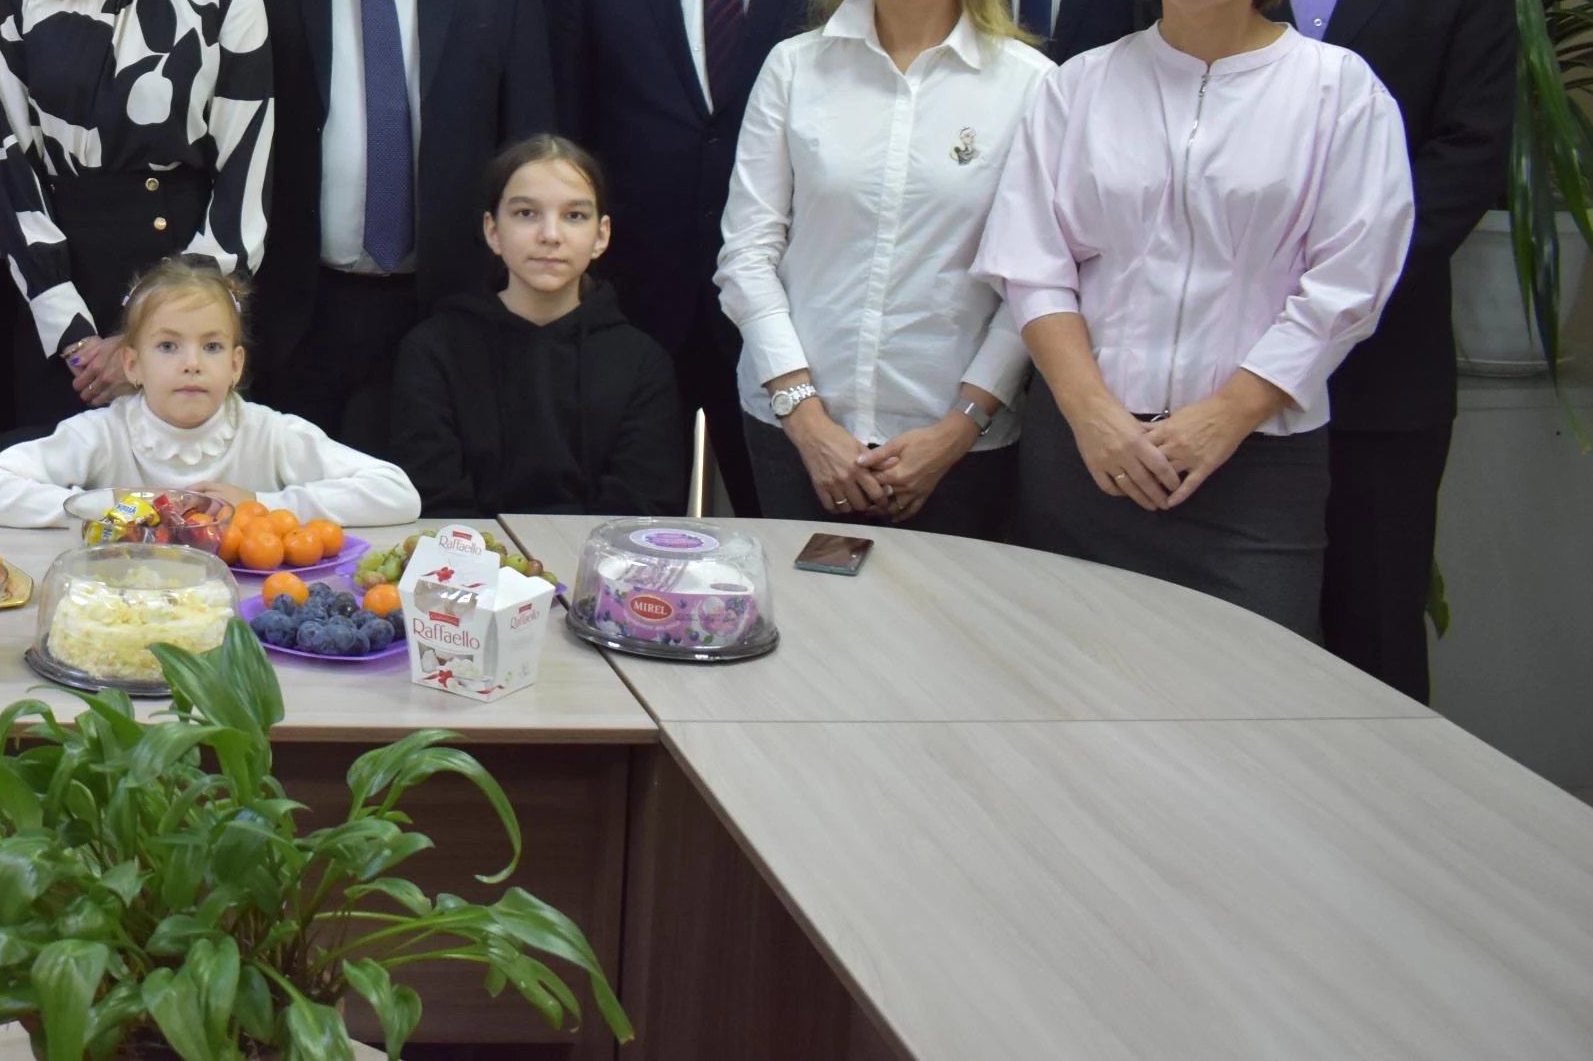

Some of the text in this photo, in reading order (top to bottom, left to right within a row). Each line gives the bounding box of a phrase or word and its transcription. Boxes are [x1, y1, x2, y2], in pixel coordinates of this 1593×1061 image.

[438, 535, 482, 556] Raffaello
[633, 600, 668, 615] MIREL
[510, 608, 540, 630] Raffaello
[412, 617, 481, 651] Raffaello
